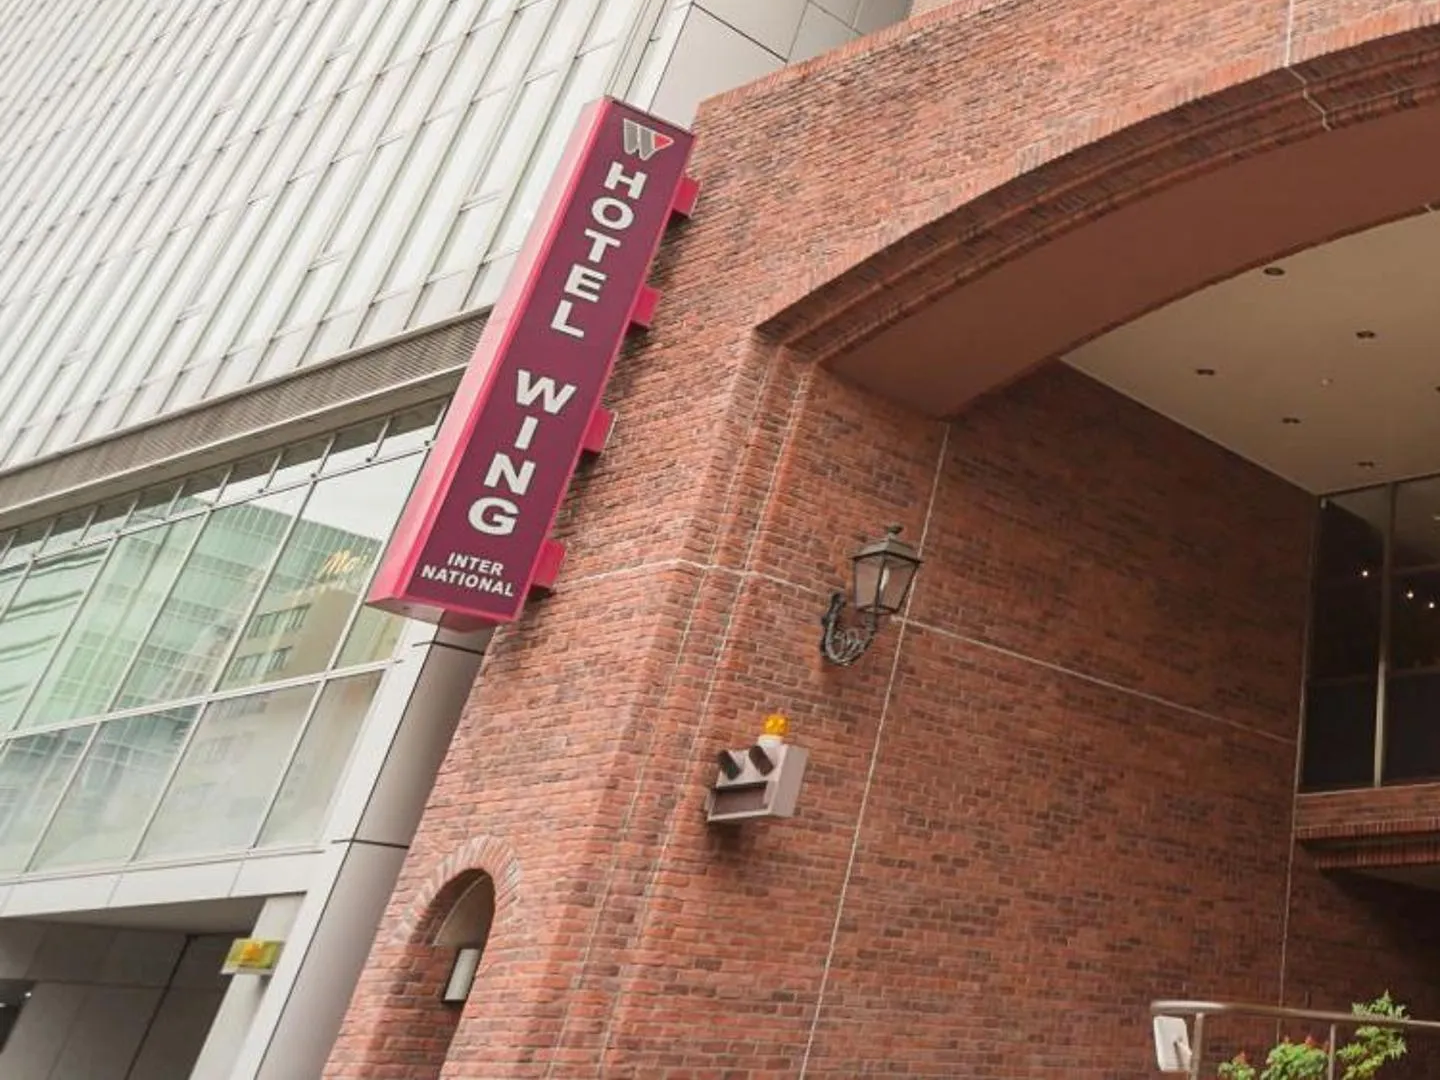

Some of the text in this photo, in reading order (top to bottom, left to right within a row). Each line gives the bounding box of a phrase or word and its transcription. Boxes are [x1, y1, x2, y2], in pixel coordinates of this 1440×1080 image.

[469, 162, 646, 536] HOTEL WING
[447, 551, 505, 577] INTER
[421, 565, 514, 598] NATIONAL
